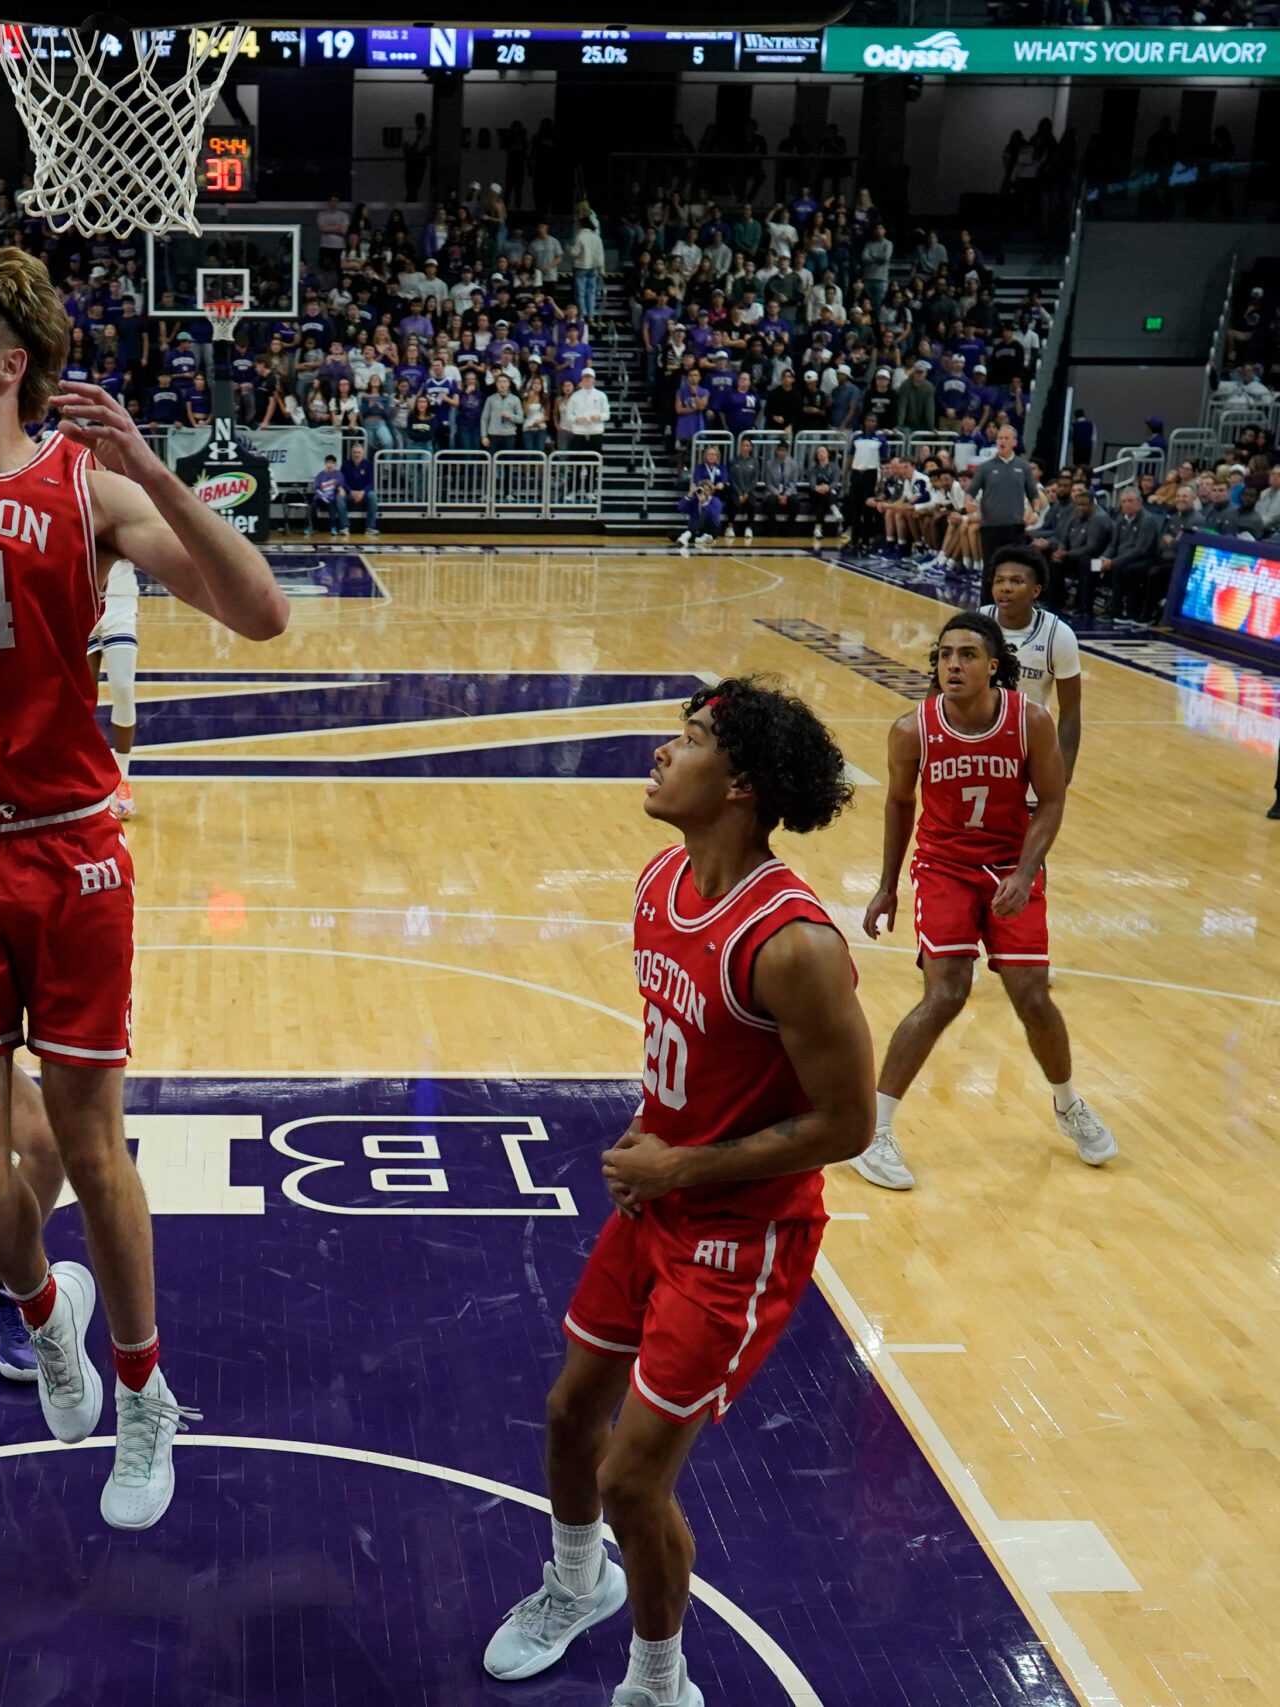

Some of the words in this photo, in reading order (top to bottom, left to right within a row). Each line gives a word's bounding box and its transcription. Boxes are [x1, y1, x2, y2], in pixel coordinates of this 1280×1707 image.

[188, 29, 260, 59] 9:44
[317, 30, 355, 59] 19
[429, 28, 456, 67] N
[497, 45, 525, 63] 2/8
[581, 46, 628, 64] 25.0%
[693, 47, 704, 65] 5
[863, 43, 969, 72] Odyssey
[1014, 41, 1098, 64] WHAT'S
[1102, 42, 1165, 64] YOUR
[1168, 42, 1267, 65] FLAVOR?
[209, 138, 247, 155] 9:44
[206, 158, 242, 191] 30
[215, 418, 232, 441] N
[930, 755, 1019, 783] BOSTON
[962, 786, 989, 828] 7
[74, 857, 121, 895] BU
[633, 950, 706, 1034] BOSTON
[643, 1002, 688, 1110] 20
